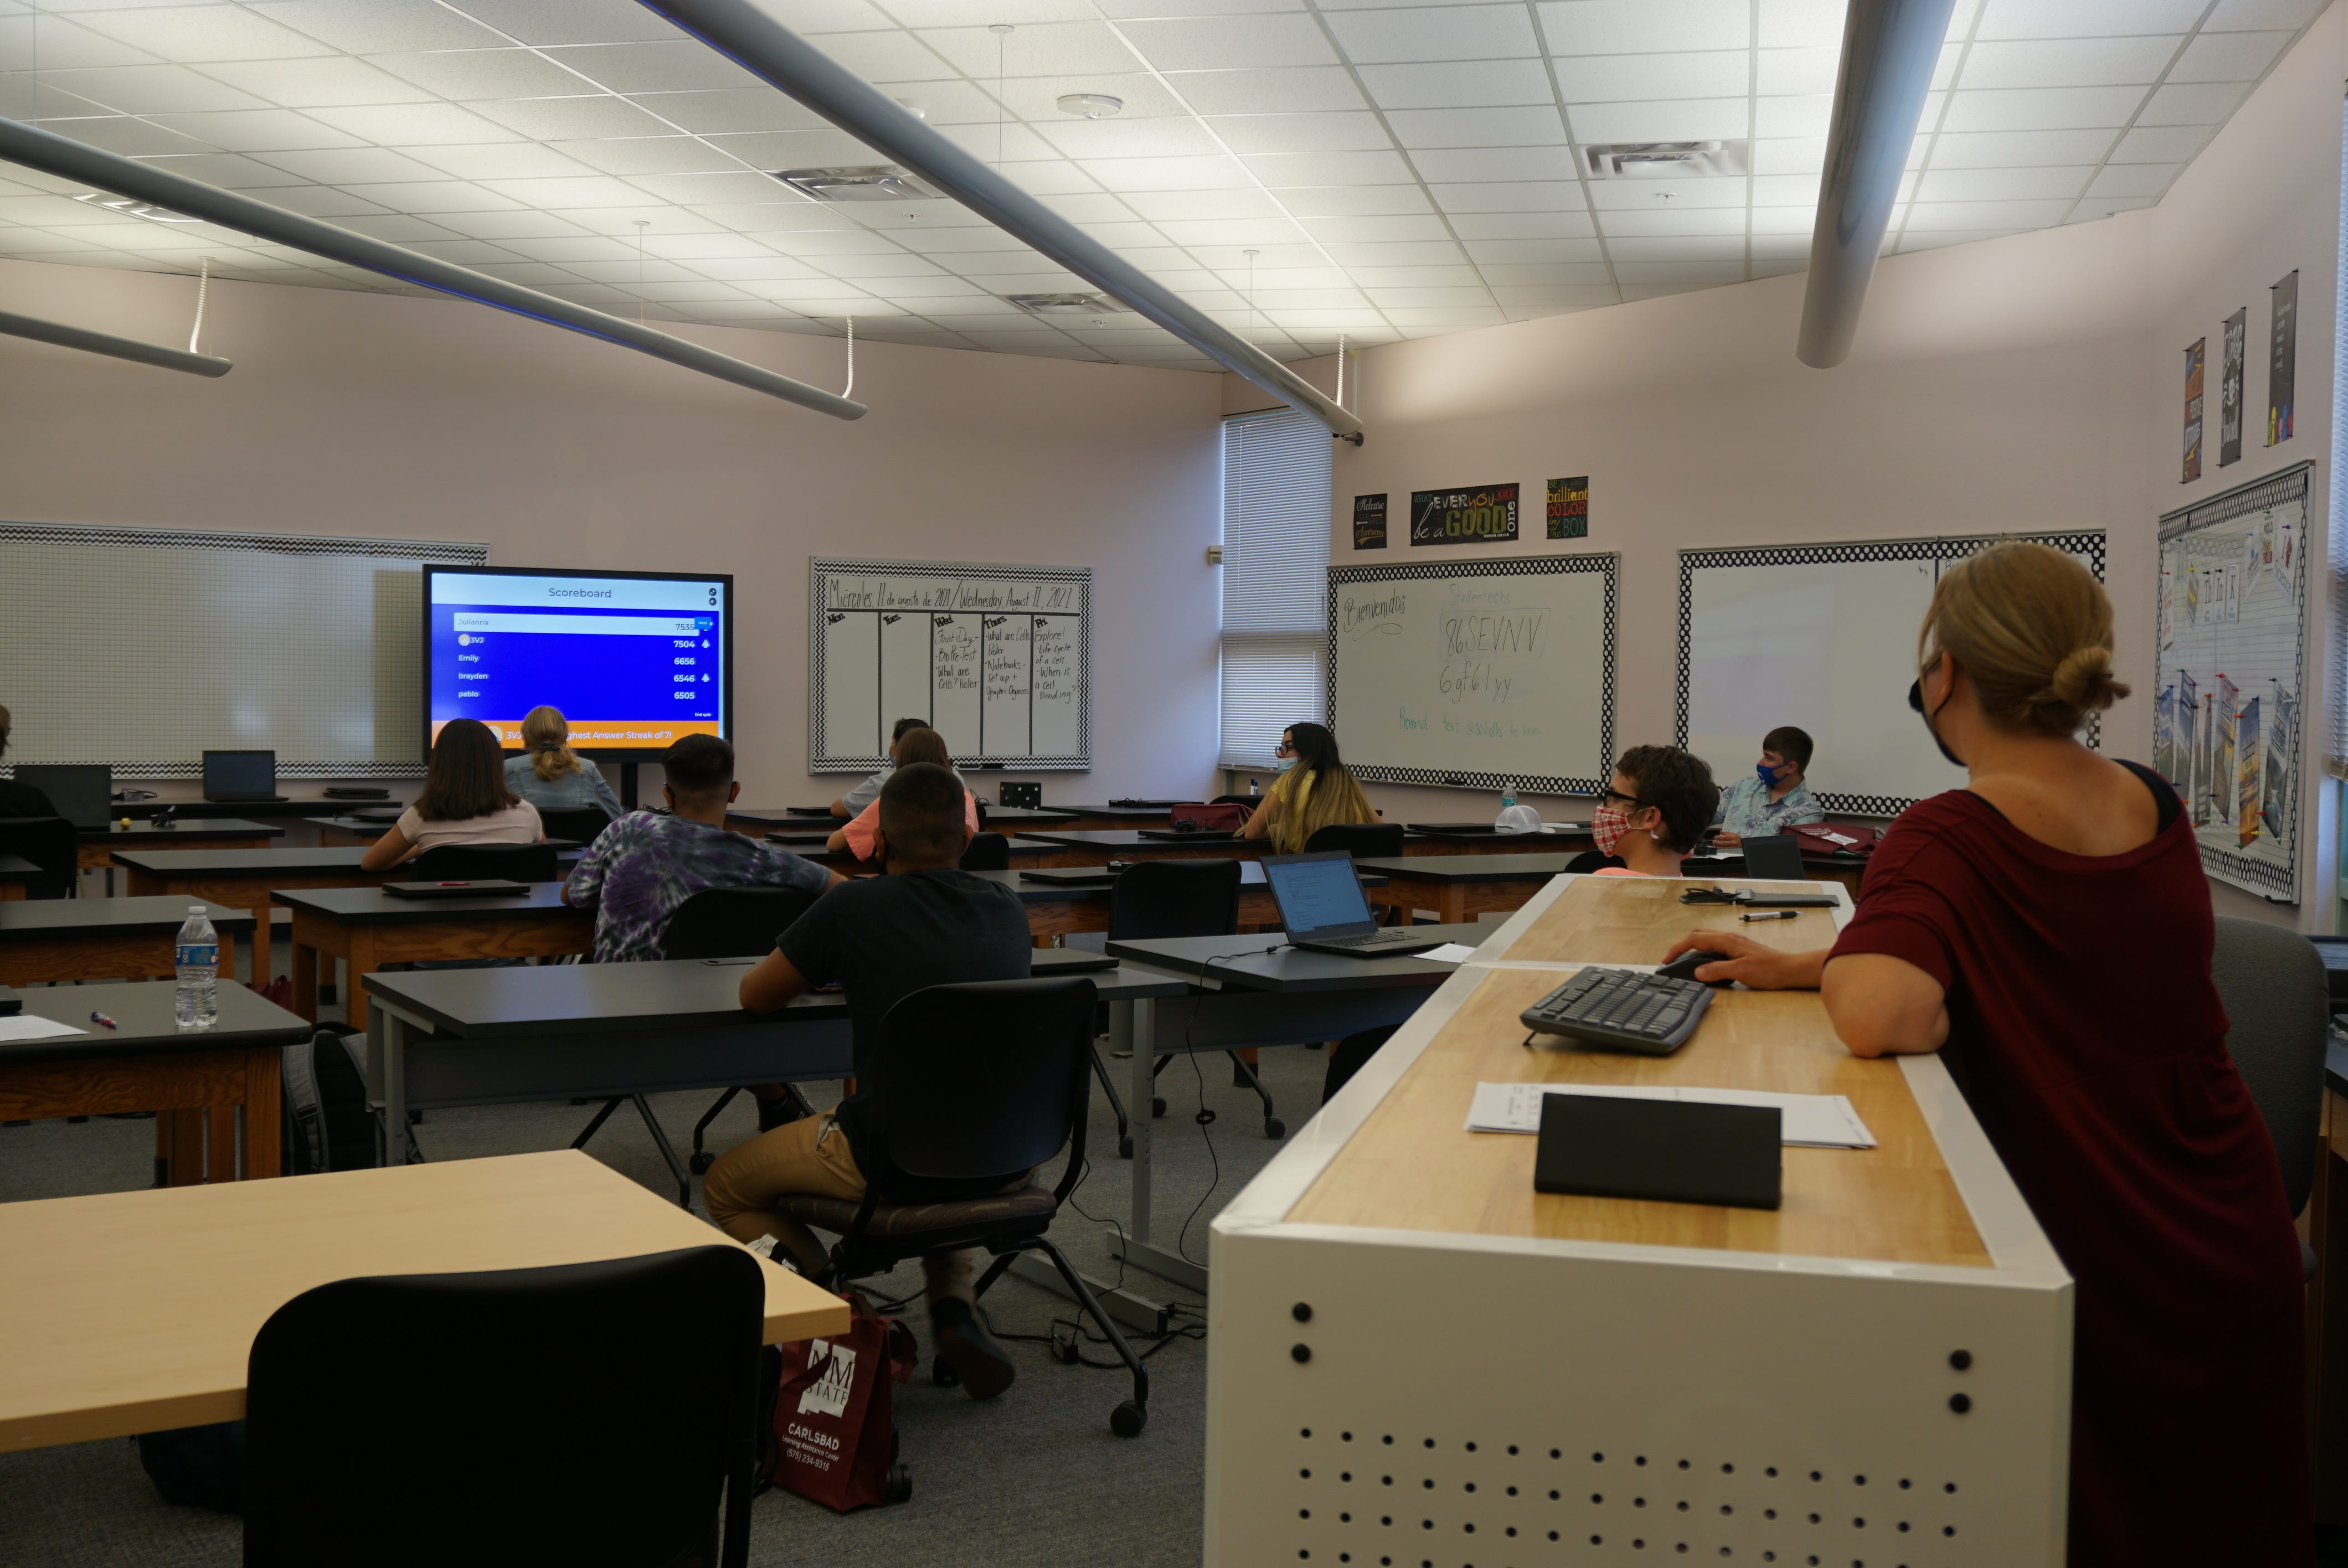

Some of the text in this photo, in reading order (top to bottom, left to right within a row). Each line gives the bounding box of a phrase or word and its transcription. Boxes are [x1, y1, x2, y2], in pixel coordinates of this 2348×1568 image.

[1434, 494, 1468, 509] EVER
[1496, 488, 1516, 501] ARE
[1547, 486, 1589, 503] brilliant
[1357, 497, 1384, 511] Release
[1547, 501, 1587, 517] COLOR
[1414, 501, 1516, 539] be a GOOD one
[1563, 517, 1586, 537] BOX
[548, 587, 612, 599] Scoreboard
[877, 582, 885, 607] 11
[887, 591, 895, 605] de
[898, 590, 919, 608] agosto
[923, 592, 931, 606] de
[1006, 587, 1029, 611] August
[1047, 587, 1072, 608] 2021
[1343, 587, 1406, 633] Bienvenidos
[987, 627, 1030, 642] What are Cells
[988, 643, 1003, 656] Poster
[458, 654, 480, 663] Emily
[1036, 656, 1043, 664] of
[938, 664, 970, 677] What are
[1040, 666, 1071, 677] When is
[960, 678, 978, 689] Poster
[1000, 675, 1009, 684] up
[567, 731, 591, 741] ghest
[626, 731, 653, 739] Streak
[655, 731, 664, 739] of
[788, 1423, 840, 1451] CARLSBAD
[782, 1435, 840, 1462] Learning Assistance Center
[786, 1448, 830, 1471] (575) 234-9315
